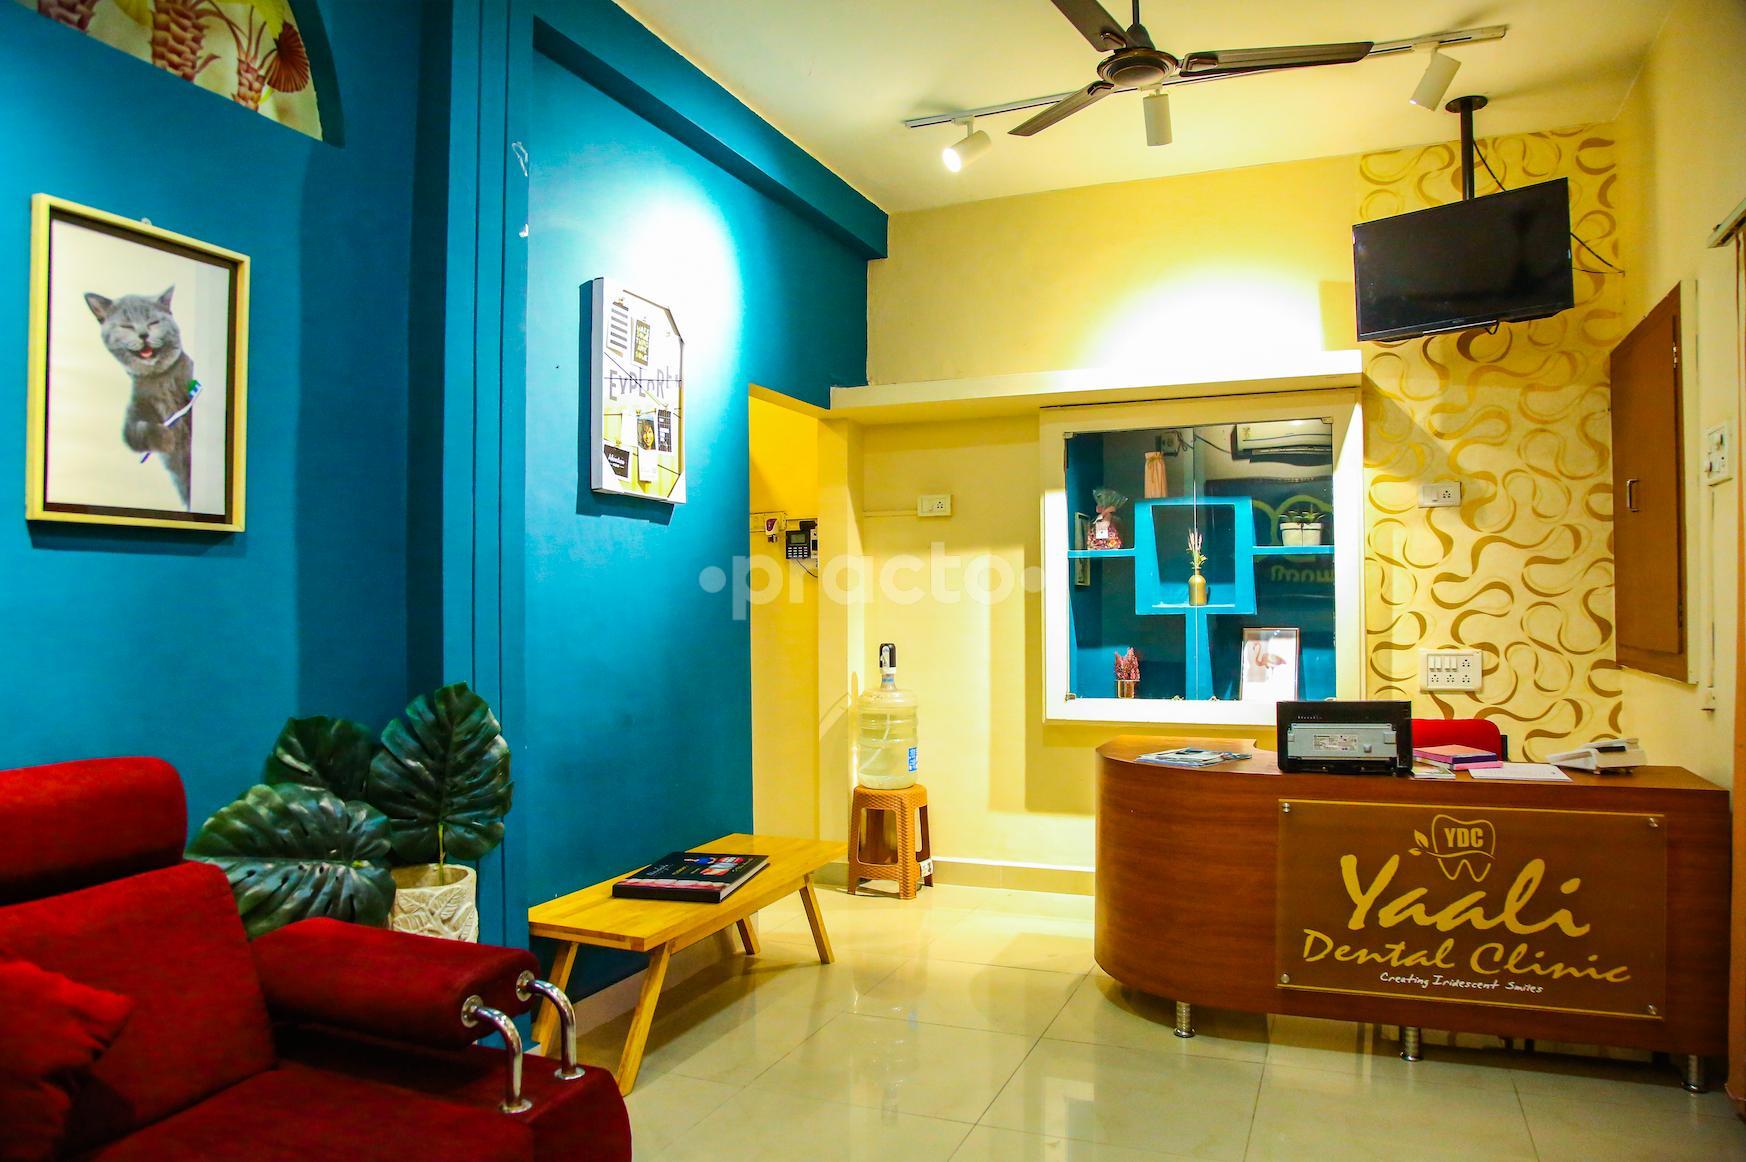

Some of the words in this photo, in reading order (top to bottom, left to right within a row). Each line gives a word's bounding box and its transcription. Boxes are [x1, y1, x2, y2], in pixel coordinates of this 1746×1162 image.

[1444, 827, 1484, 848] YDC
[1340, 854, 1590, 937] Yaali
[1303, 928, 1455, 970] Dental
[1470, 942, 1632, 983] Clinic
[1379, 972, 1428, 988] Creating
[1432, 974, 1499, 990] Iridescent
[1505, 980, 1544, 994] Smiles
